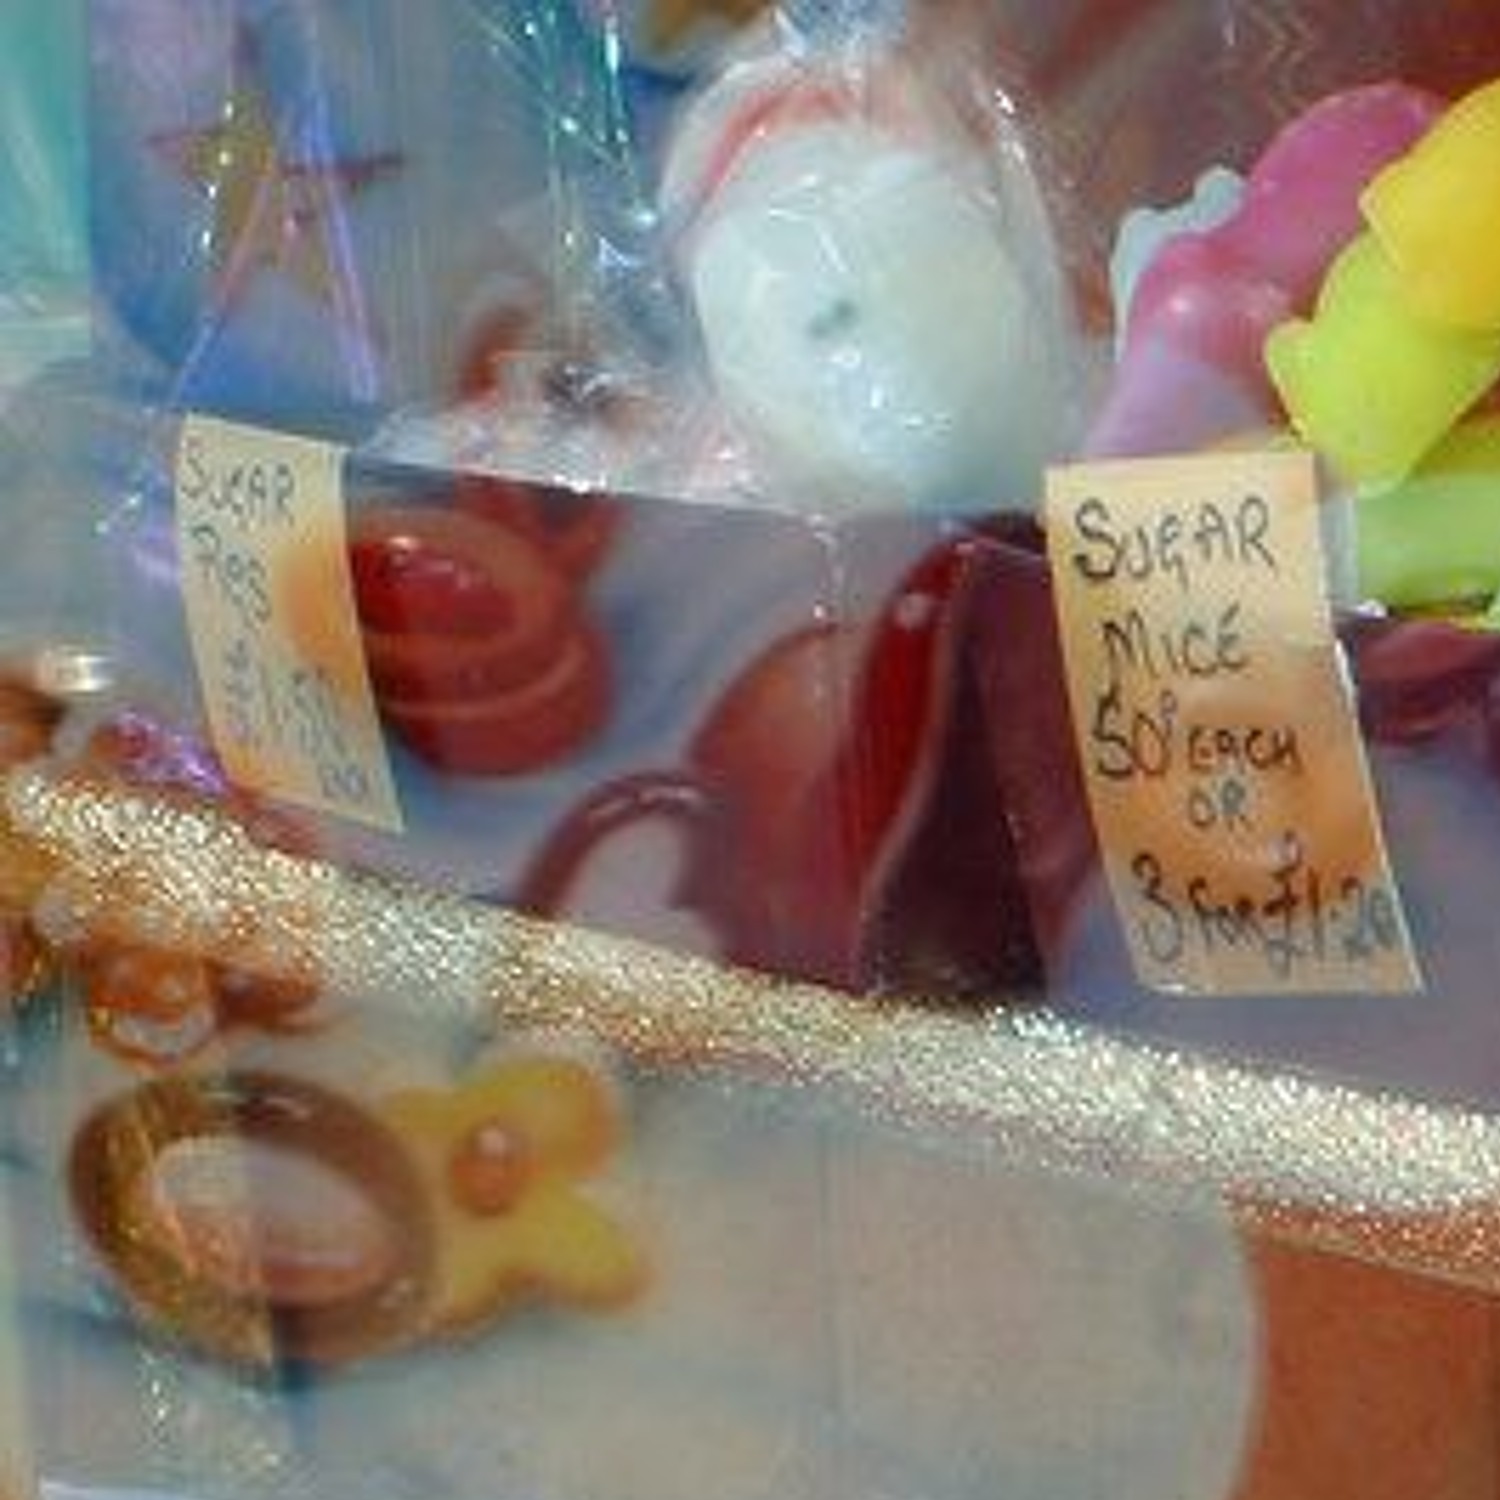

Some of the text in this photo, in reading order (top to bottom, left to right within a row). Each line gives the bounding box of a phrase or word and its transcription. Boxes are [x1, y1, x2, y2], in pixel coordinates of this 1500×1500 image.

[1073, 498, 1275, 589] SUGAR
[1101, 606, 1247, 686] MICE
[1188, 779, 1247, 831] OR
[1131, 851, 1183, 964] 3
